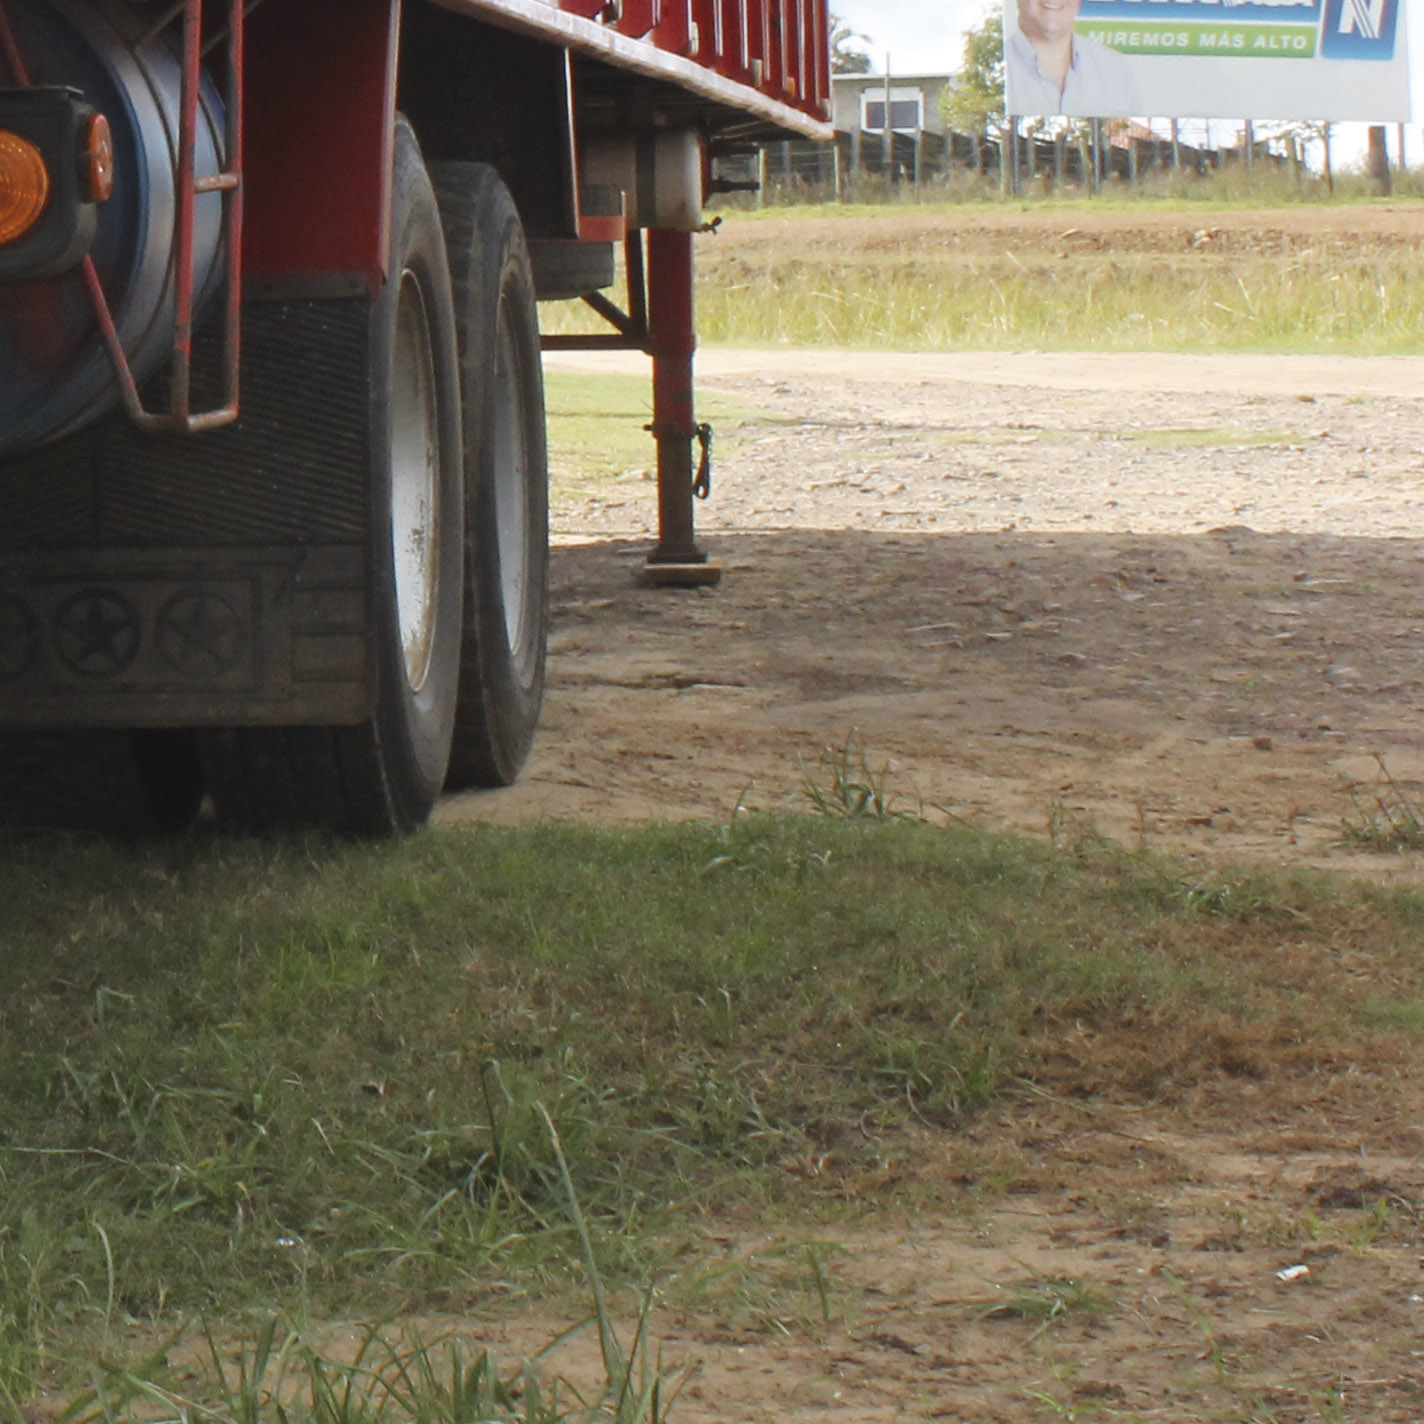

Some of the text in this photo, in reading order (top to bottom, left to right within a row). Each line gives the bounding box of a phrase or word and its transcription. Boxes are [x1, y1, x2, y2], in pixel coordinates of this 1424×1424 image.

[1087, 30, 1307, 50] MIREMOS MÁS ALTO
